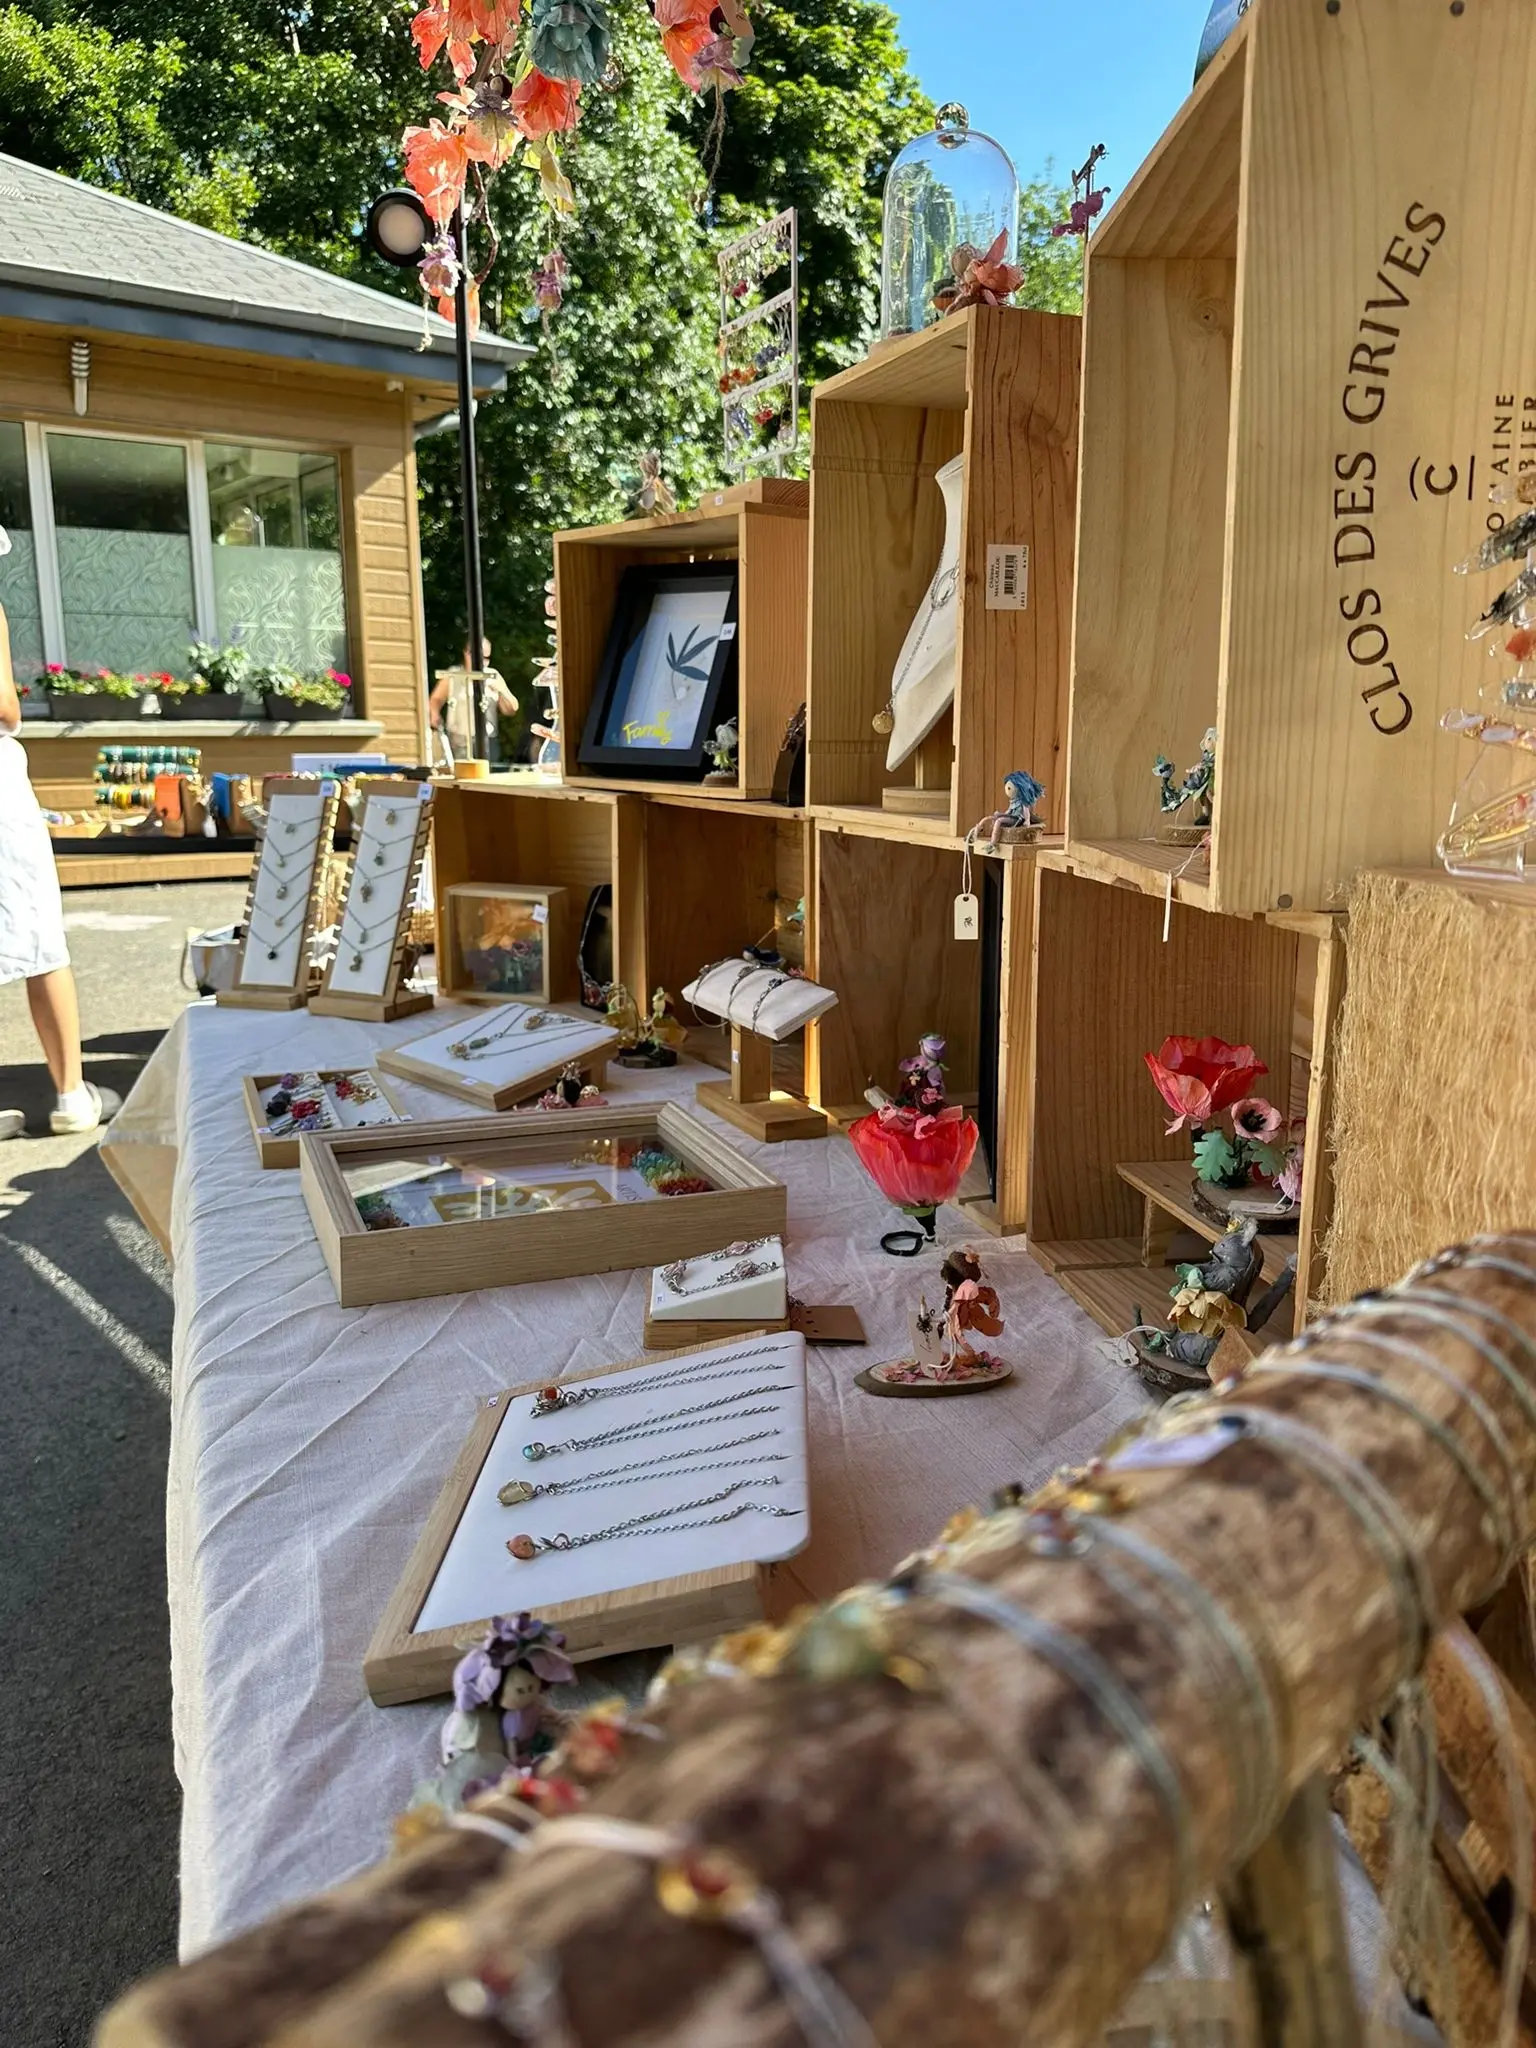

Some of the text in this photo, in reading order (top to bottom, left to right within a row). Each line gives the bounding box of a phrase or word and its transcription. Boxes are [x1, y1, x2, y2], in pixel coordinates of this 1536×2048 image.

[1333, 201, 1446, 735] CLOS DES GRIVES
[1486, 394, 1514, 533] OAINE
